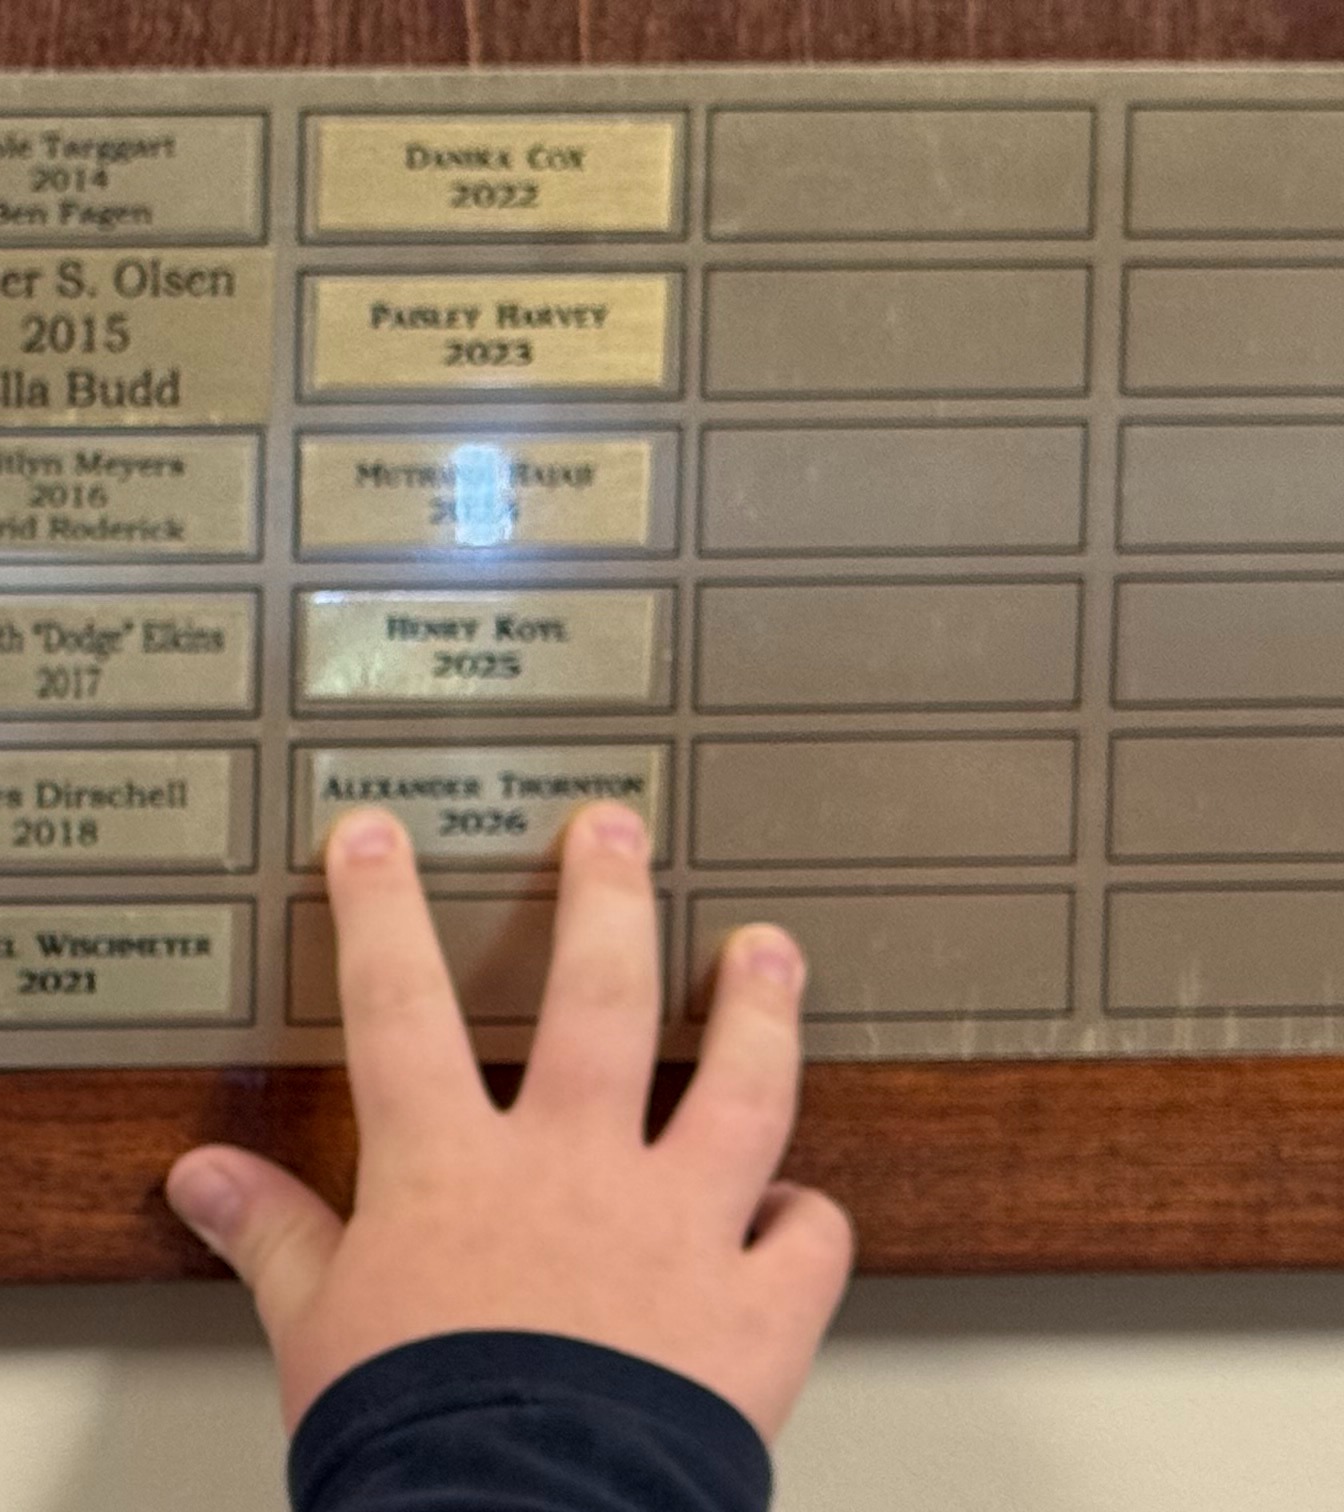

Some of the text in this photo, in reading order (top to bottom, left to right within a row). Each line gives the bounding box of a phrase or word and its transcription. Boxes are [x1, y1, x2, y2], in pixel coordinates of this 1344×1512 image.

[30, 168, 110, 194] 2014
[450, 180, 541, 209] 2022
[55, 260, 99, 300] S.
[113, 256, 238, 299] Olsen
[20, 311, 132, 354] 2015
[443, 339, 534, 367] 2023
[65, 366, 182, 407] Budd
[74, 448, 186, 482] Meyers
[28, 485, 111, 510] 2016
[48, 512, 185, 542] Roderick
[432, 651, 523, 679] 2025
[34, 666, 103, 700] 2017
[34, 777, 189, 810] Dirschell
[13, 818, 100, 848] 2018
[439, 808, 529, 837] 2026
[16, 968, 99, 996] 2021
